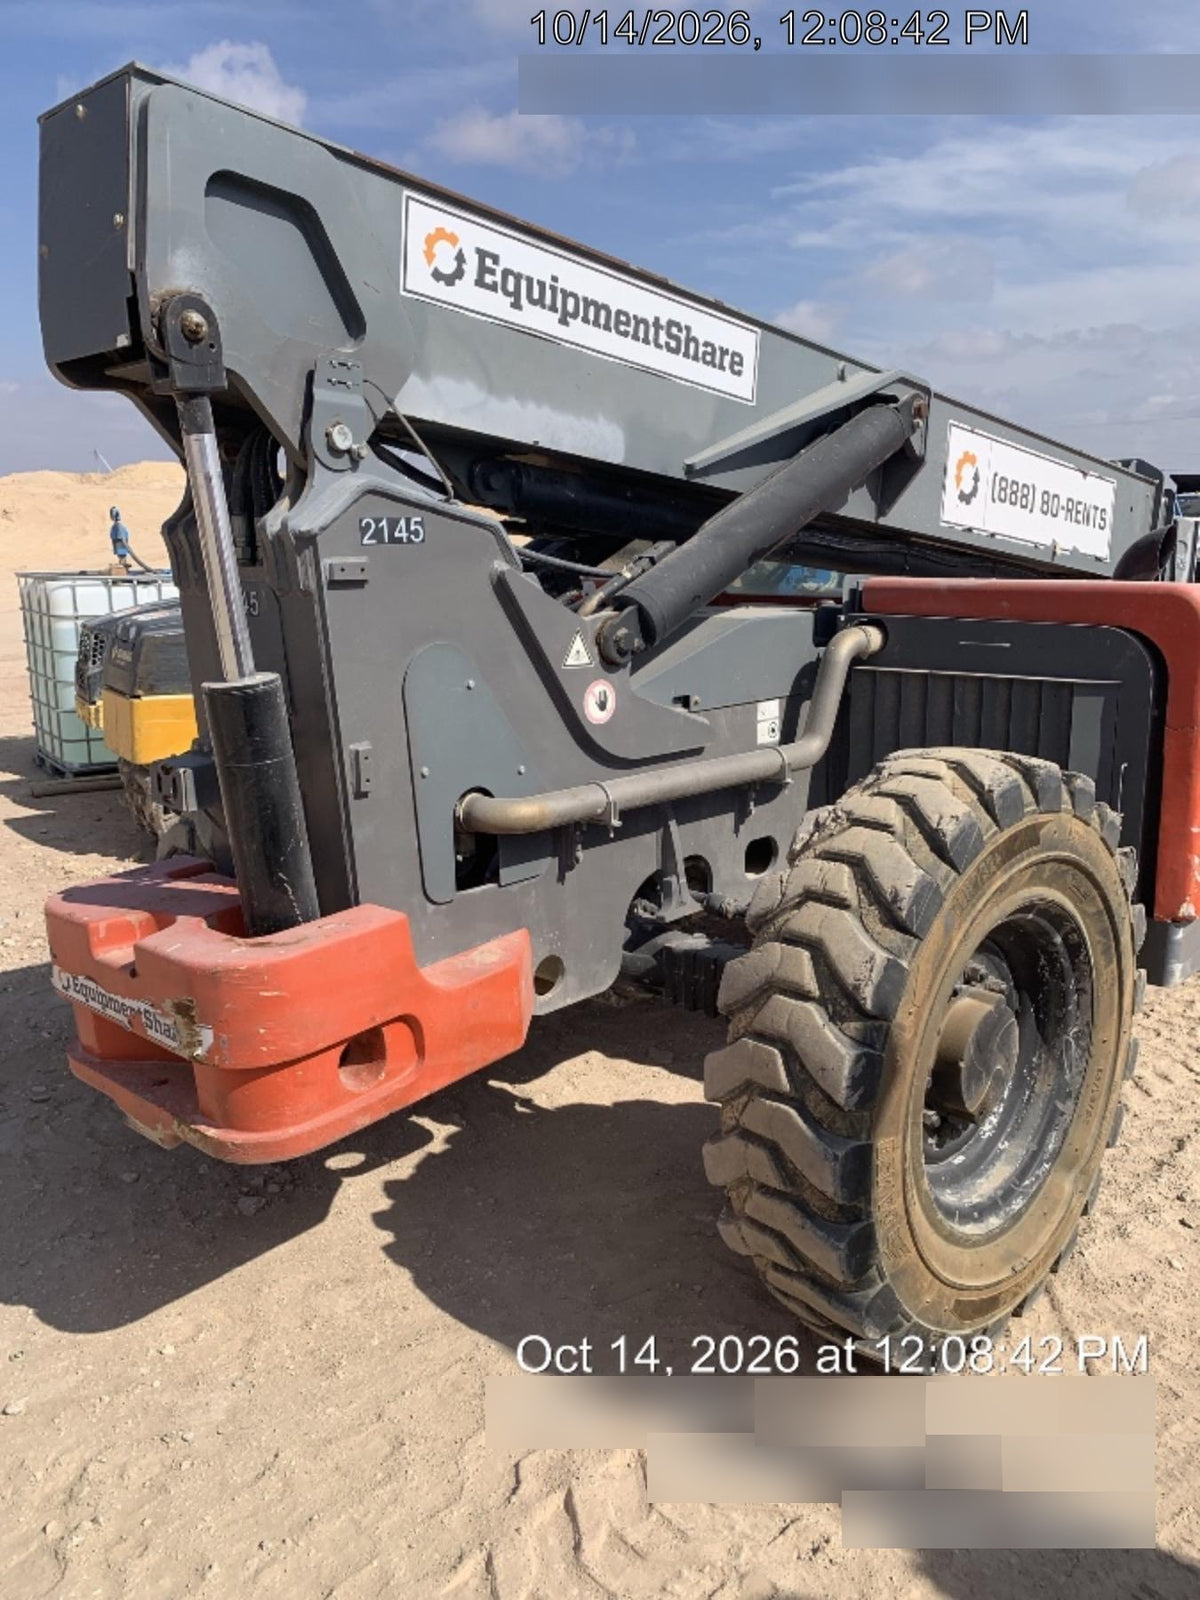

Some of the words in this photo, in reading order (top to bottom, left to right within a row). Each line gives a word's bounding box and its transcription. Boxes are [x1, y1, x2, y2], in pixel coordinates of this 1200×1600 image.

[474, 246, 745, 378] EquipmentShare
[990, 472, 1036, 515] (888)
[361, 516, 425, 545] 2145
